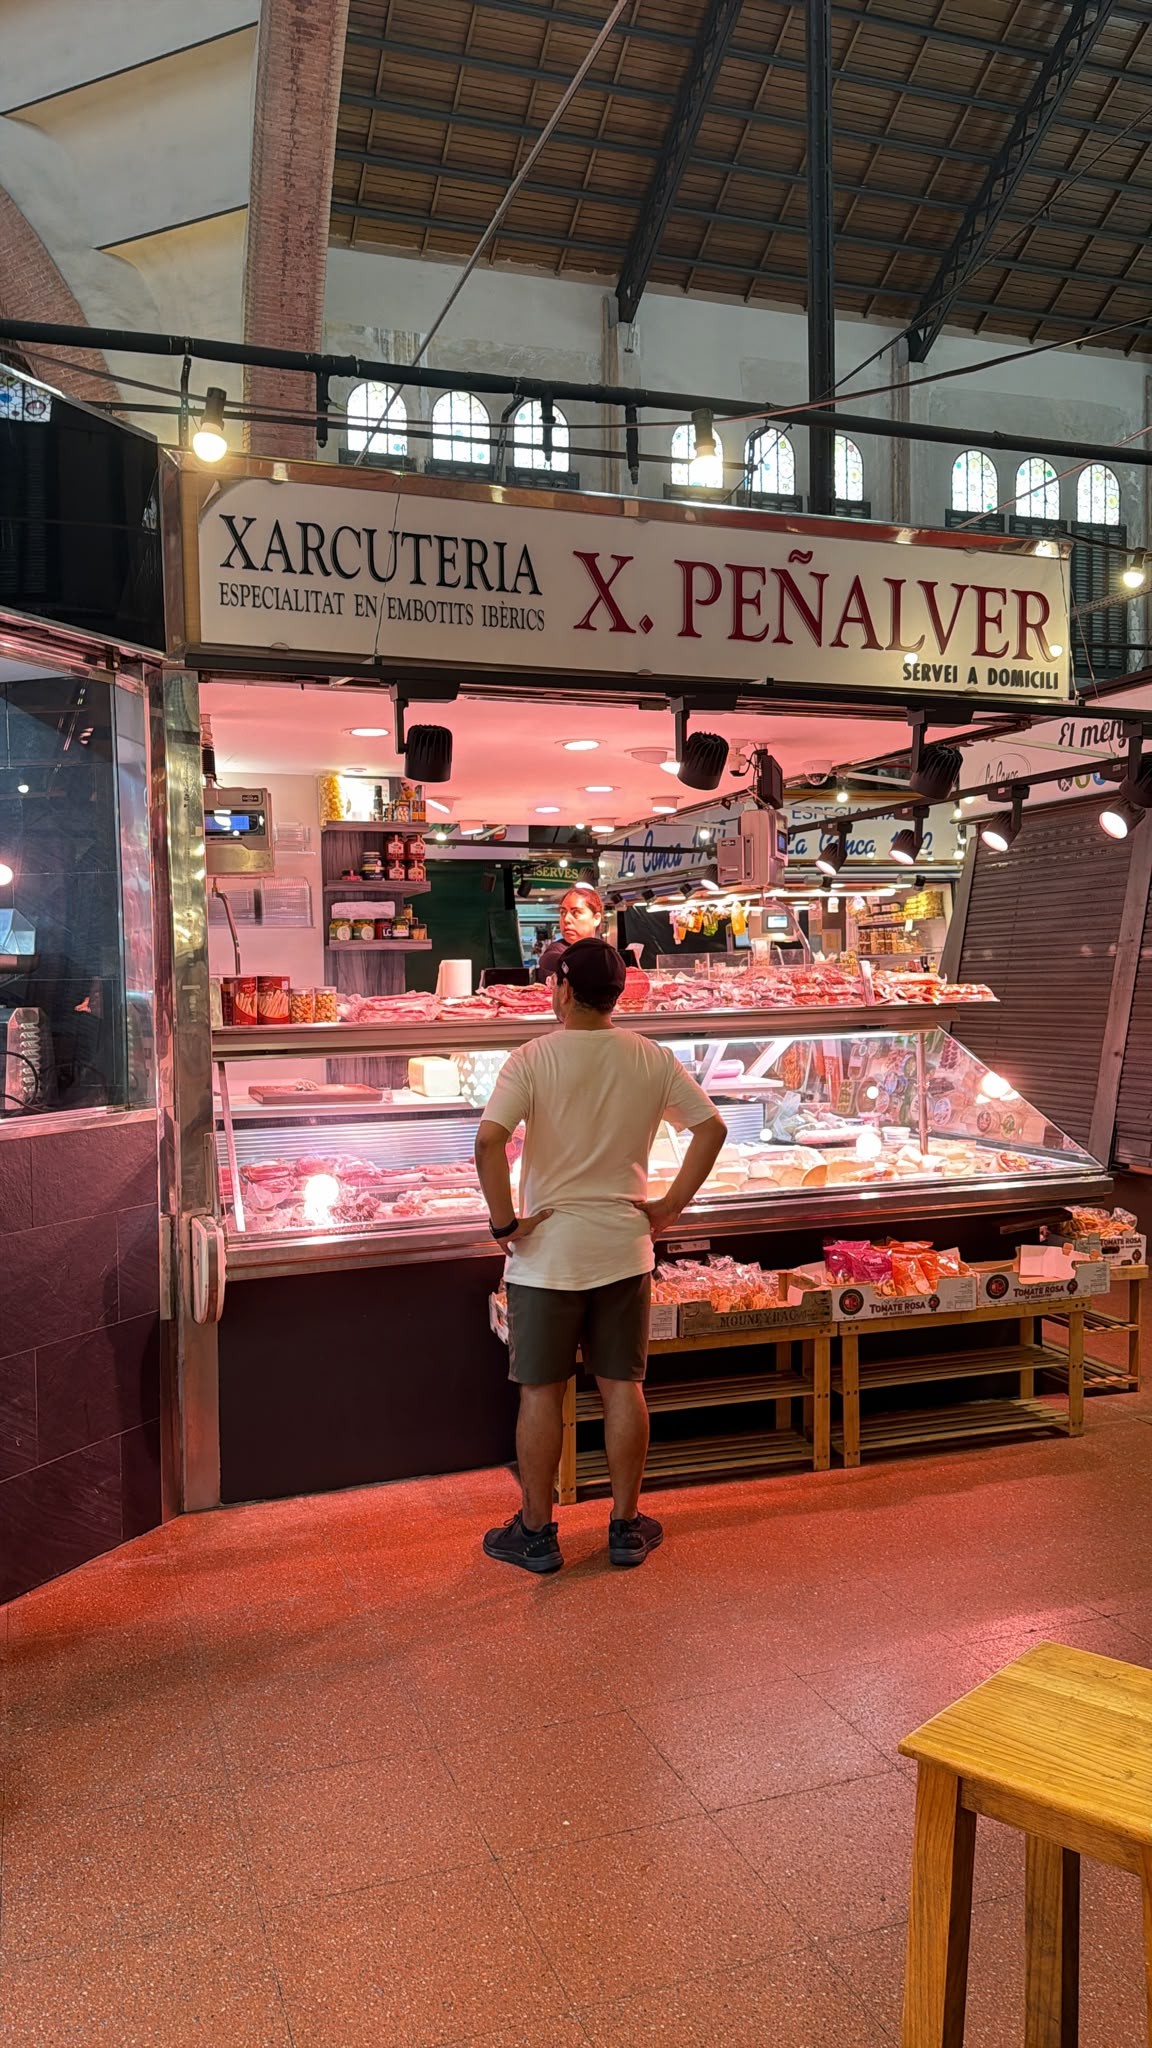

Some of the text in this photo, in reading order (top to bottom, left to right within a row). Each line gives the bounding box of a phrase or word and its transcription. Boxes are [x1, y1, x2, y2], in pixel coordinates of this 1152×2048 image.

[218, 513, 544, 596] XARCUTERIA
[218, 581, 546, 632] ESPECIALITAT EN EMBOTITS IBÈRICS
[572, 549, 1060, 663] X. PEÑALVER
[902, 662, 1060, 690] SERVEI A DOMICILI
[818, 832, 877, 856] Cnca
[1013, 1286, 1044, 1298] TOMATE
[1045, 1284, 1065, 1294] ROSA
[869, 1303, 904, 1314] TOMATE
[904, 1301, 926, 1311] ROSA
